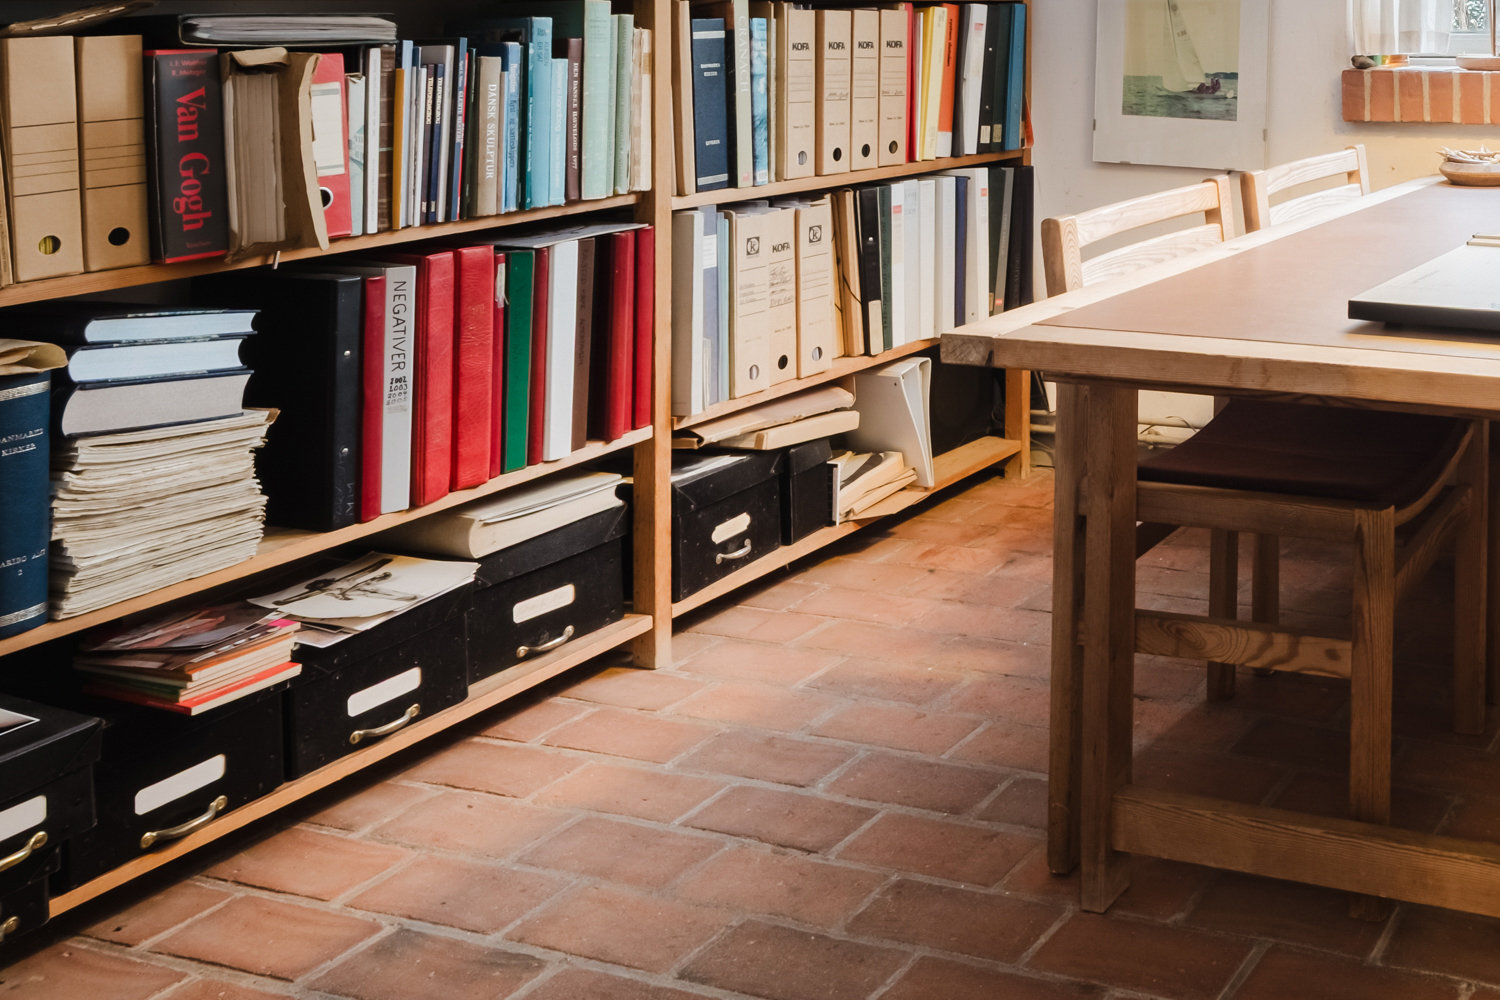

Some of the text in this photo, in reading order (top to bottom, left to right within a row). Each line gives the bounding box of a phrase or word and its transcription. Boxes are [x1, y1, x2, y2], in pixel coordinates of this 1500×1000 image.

[792, 42, 810, 51] KOFA
[828, 42, 845, 50] KOFA
[858, 40, 874, 50] KOFA
[886, 40, 903, 48] KOFA
[738, 15, 749, 93] CRANACH
[486, 84, 498, 179] DANSK SKULPTUR
[172, 86, 212, 232] Van Gogh
[772, 242, 790, 254] KOFA
[391, 280, 407, 372] NEGATIVER
[0, 428, 44, 443] ANMARKS
[0, 556, 27, 568] ARIBO
